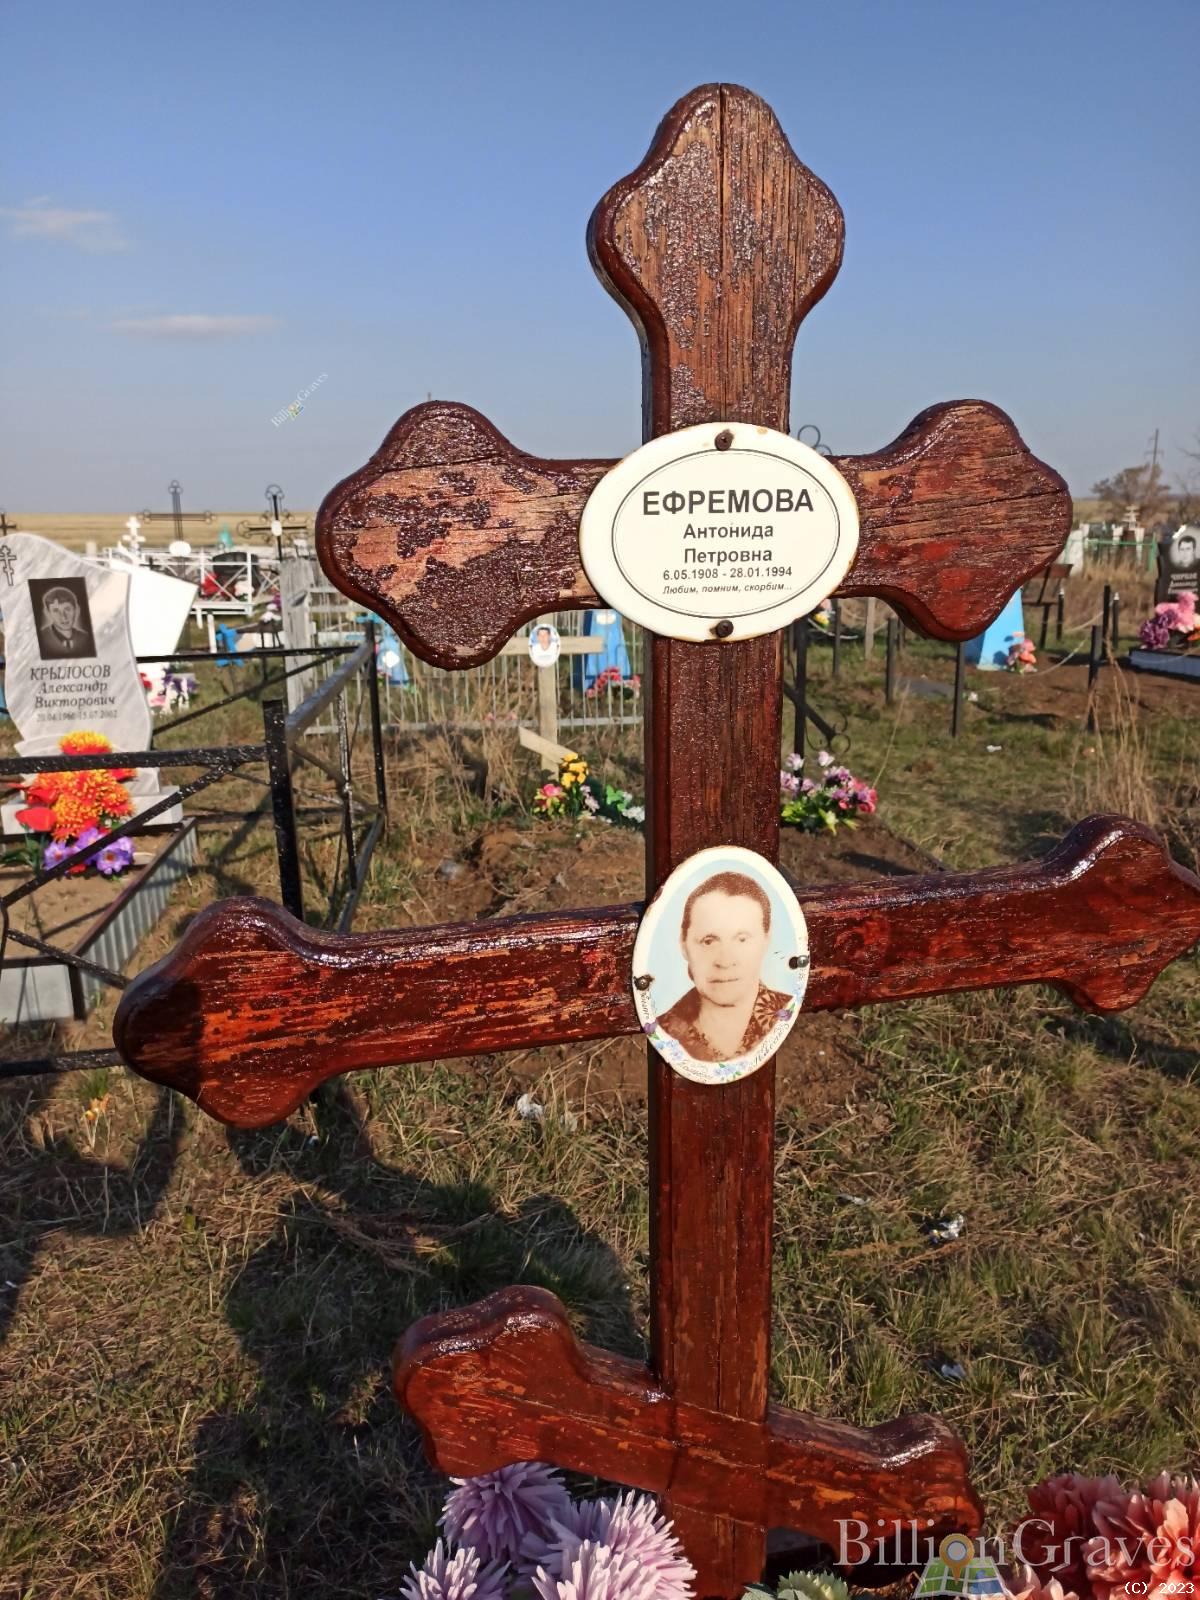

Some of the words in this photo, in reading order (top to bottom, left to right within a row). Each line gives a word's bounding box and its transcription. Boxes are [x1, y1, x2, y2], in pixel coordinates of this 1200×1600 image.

[642, 488, 815, 516] ЕФРЕМОВА
[683, 523, 774, 540] Антонида
[684, 547, 773, 567] Петровна
[663, 568, 719, 581] 6.05.1908
[729, 566, 792, 578] 28.01.1994
[662, 585, 699, 595] Любим,
[702, 583, 741, 593] помним,
[30, 664, 111, 681] КРЫЛОСОВ
[38, 680, 108, 694] Александр
[34, 696, 116, 710] Викторович
